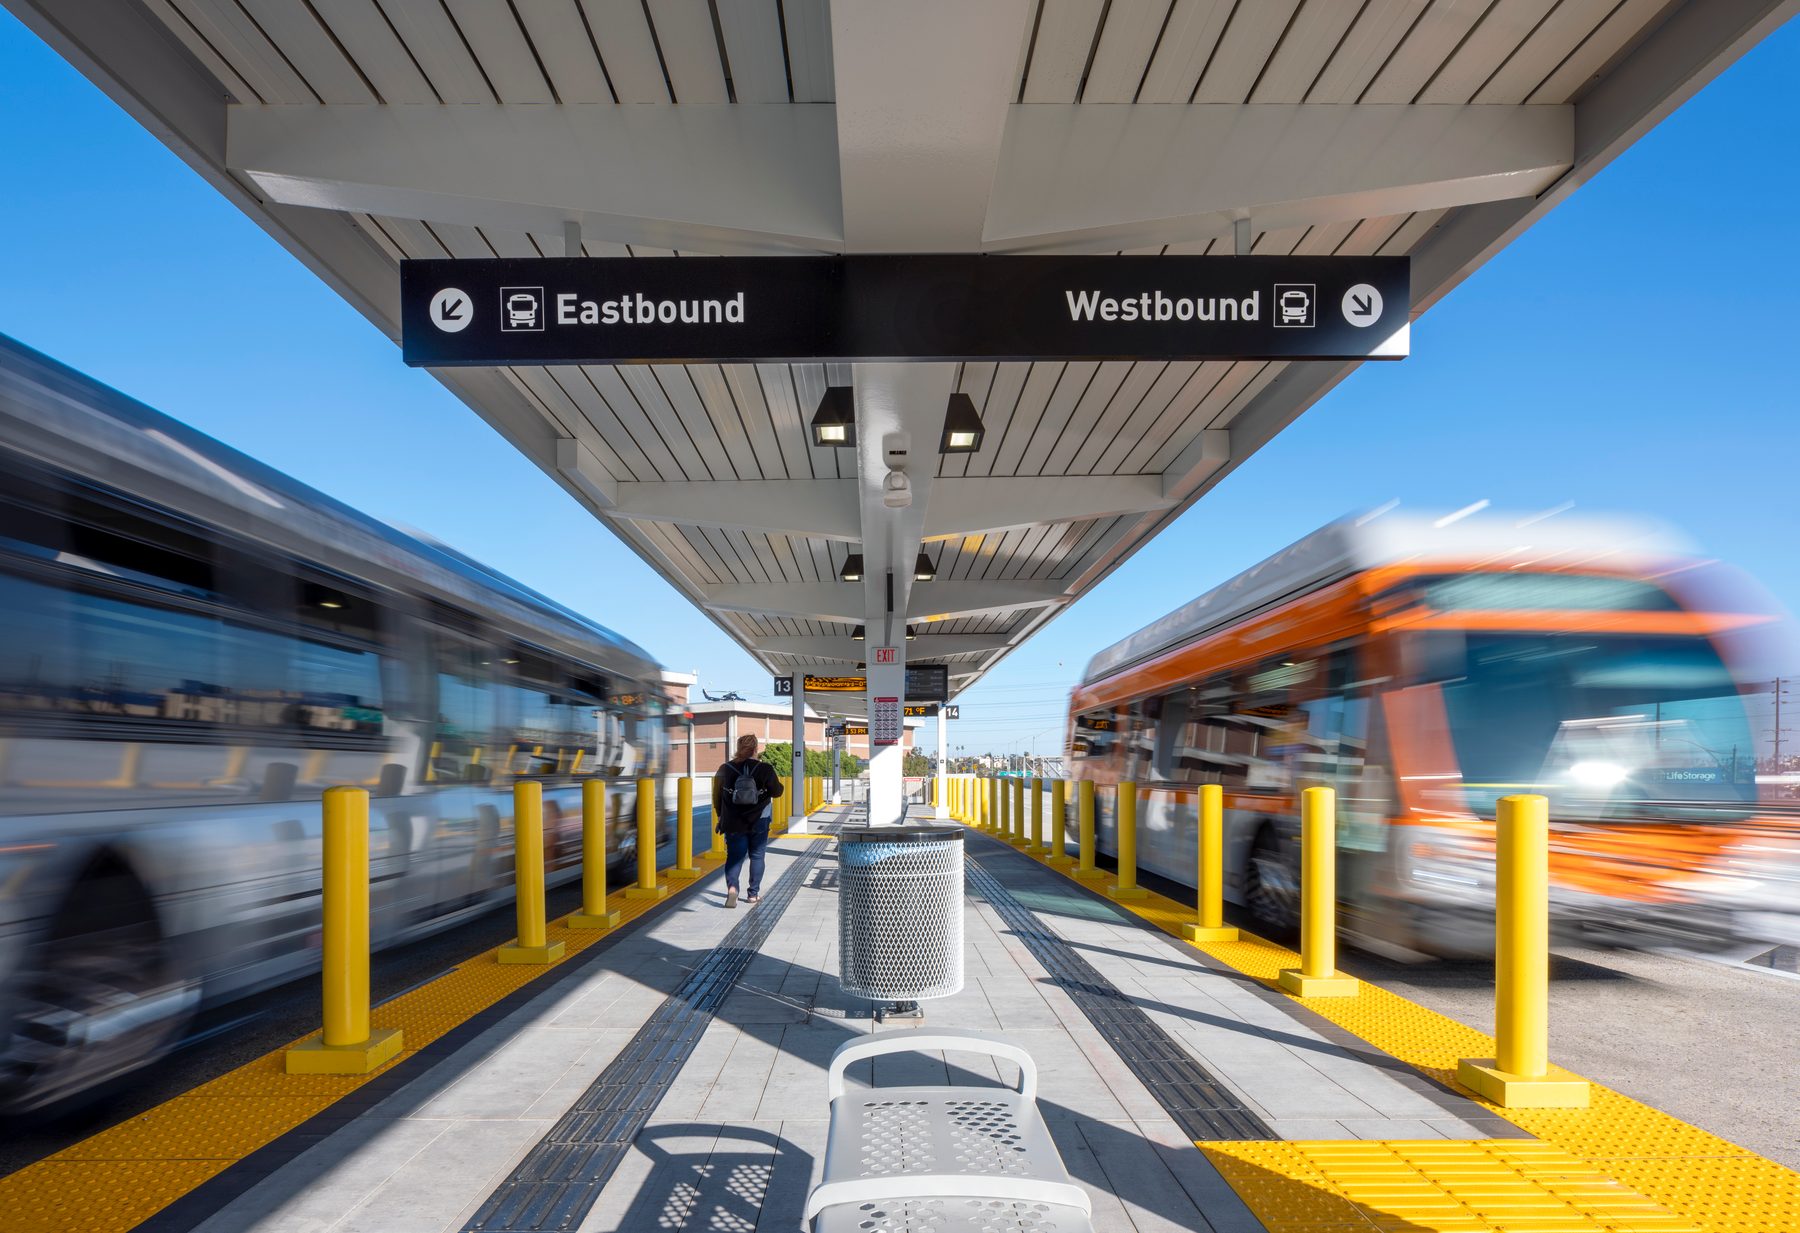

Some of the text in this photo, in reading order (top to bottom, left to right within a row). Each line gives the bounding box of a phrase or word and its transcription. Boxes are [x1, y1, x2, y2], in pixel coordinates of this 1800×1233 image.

[556, 292, 745, 325] Eastbound
[1065, 290, 1260, 321] Westbound
[876, 649, 895, 662] EXIT
[776, 680, 791, 692] 13
[904, 707, 913, 715] 71
[946, 707, 958, 717] 14
